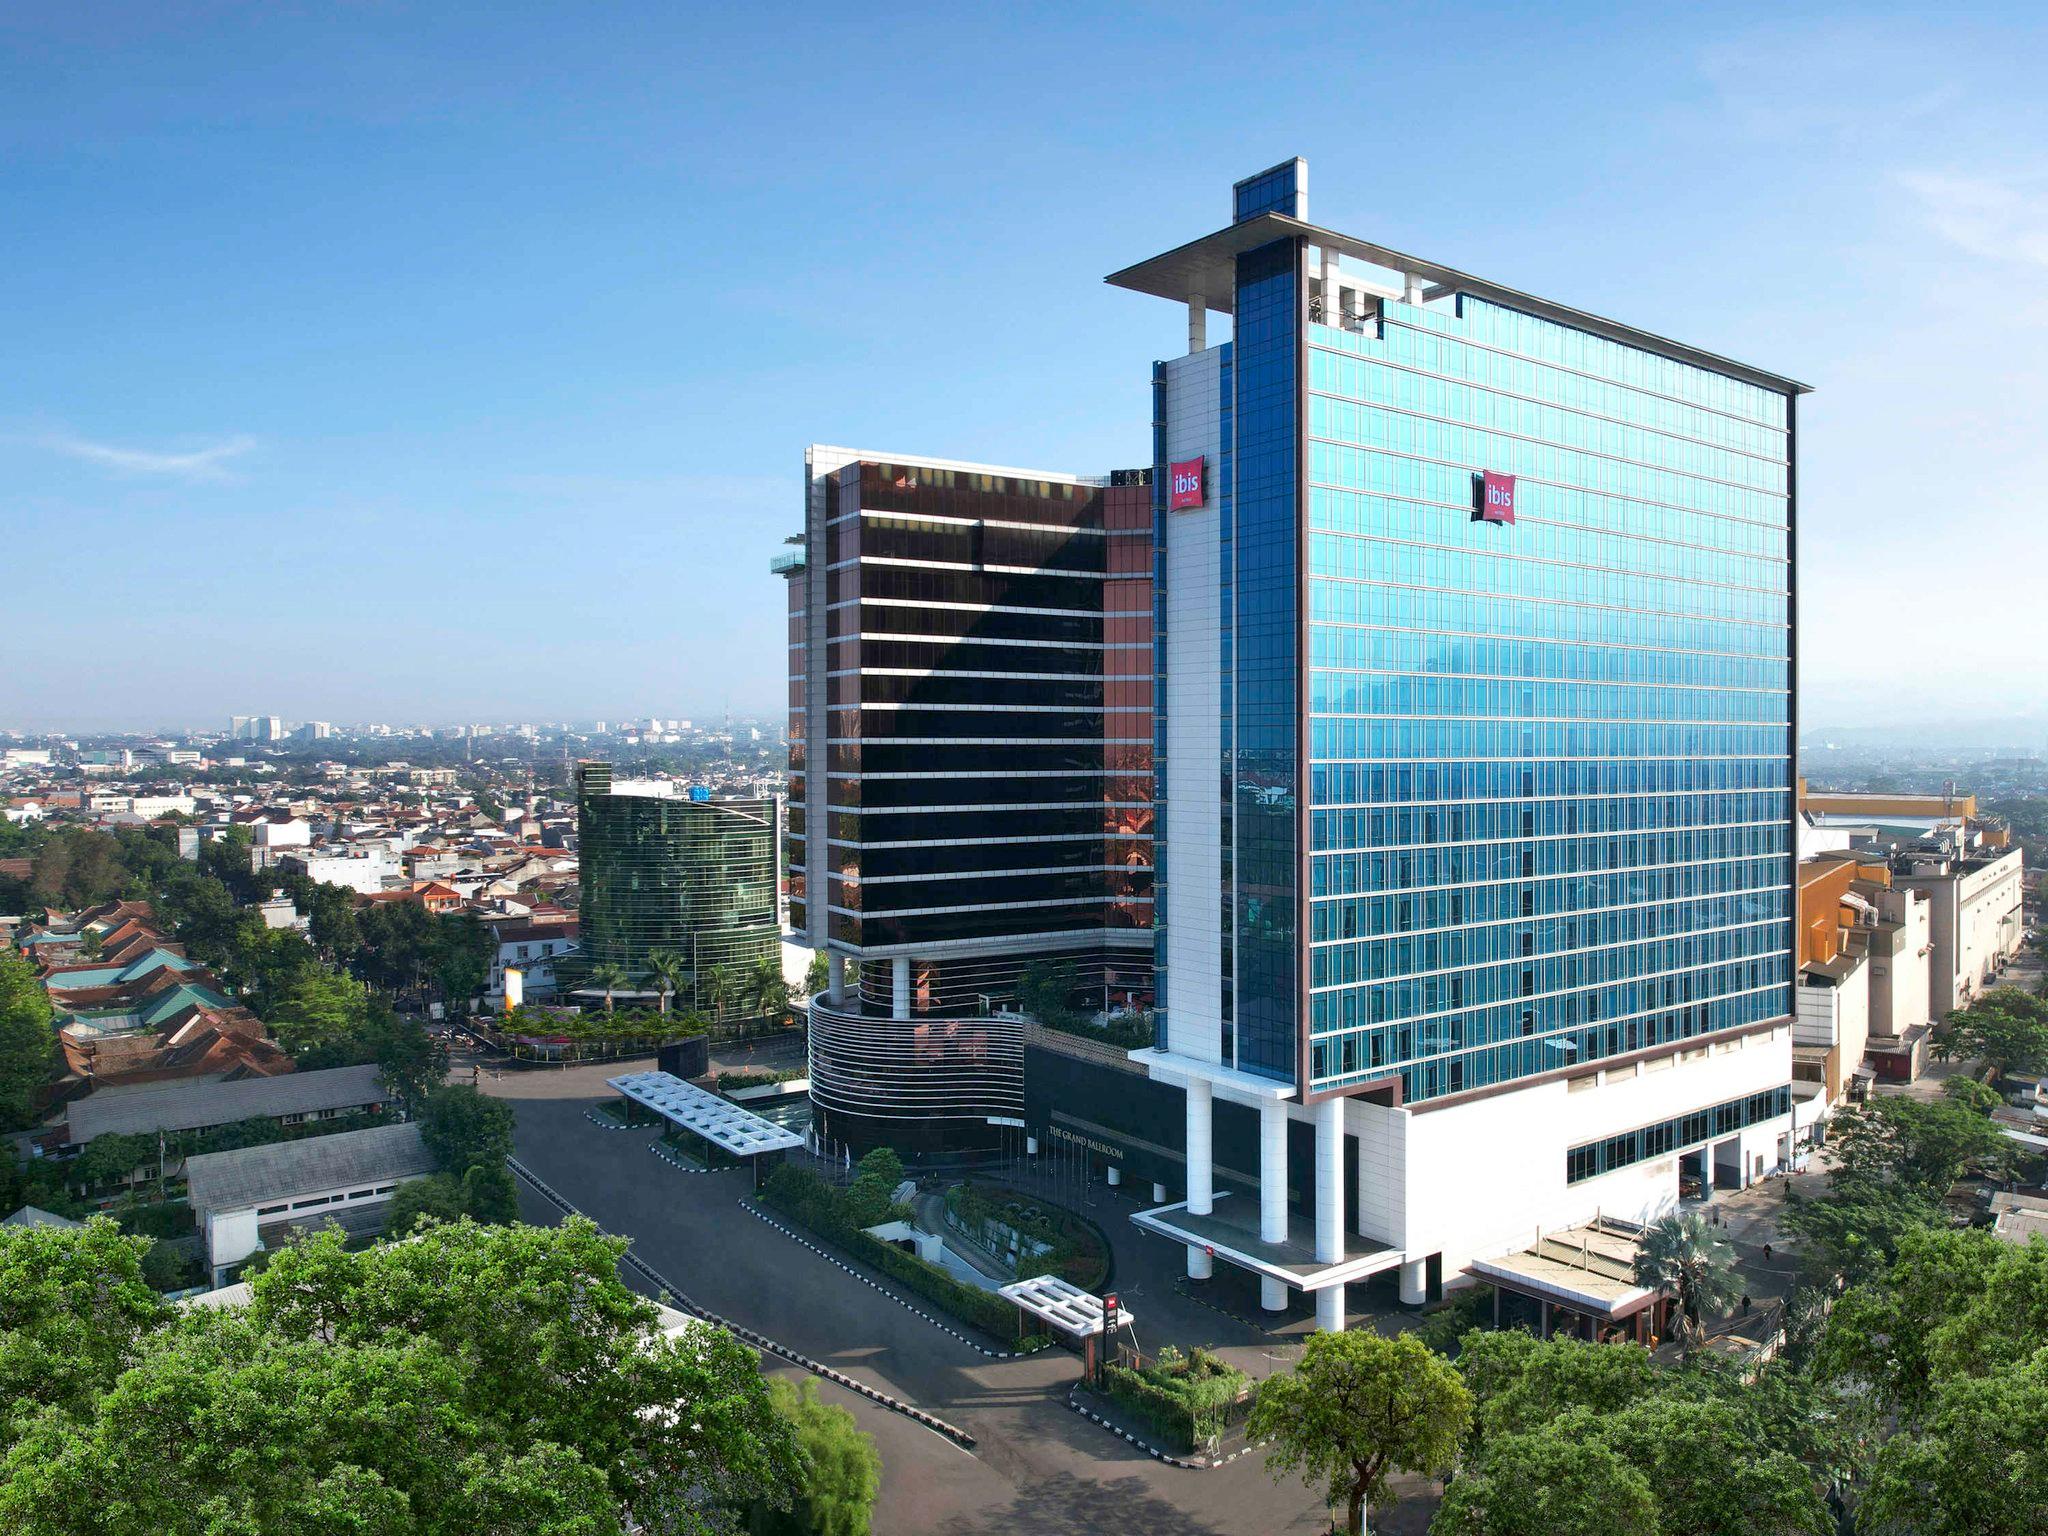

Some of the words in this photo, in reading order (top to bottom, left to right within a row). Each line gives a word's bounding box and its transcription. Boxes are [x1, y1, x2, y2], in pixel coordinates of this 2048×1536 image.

[1175, 472, 1198, 494] ibis
[1488, 484, 1511, 507] ibis
[1048, 1125, 1061, 1137] THE
[1062, 1130, 1086, 1146] GRAND
[1087, 1138, 1124, 1160] BALLROOM
